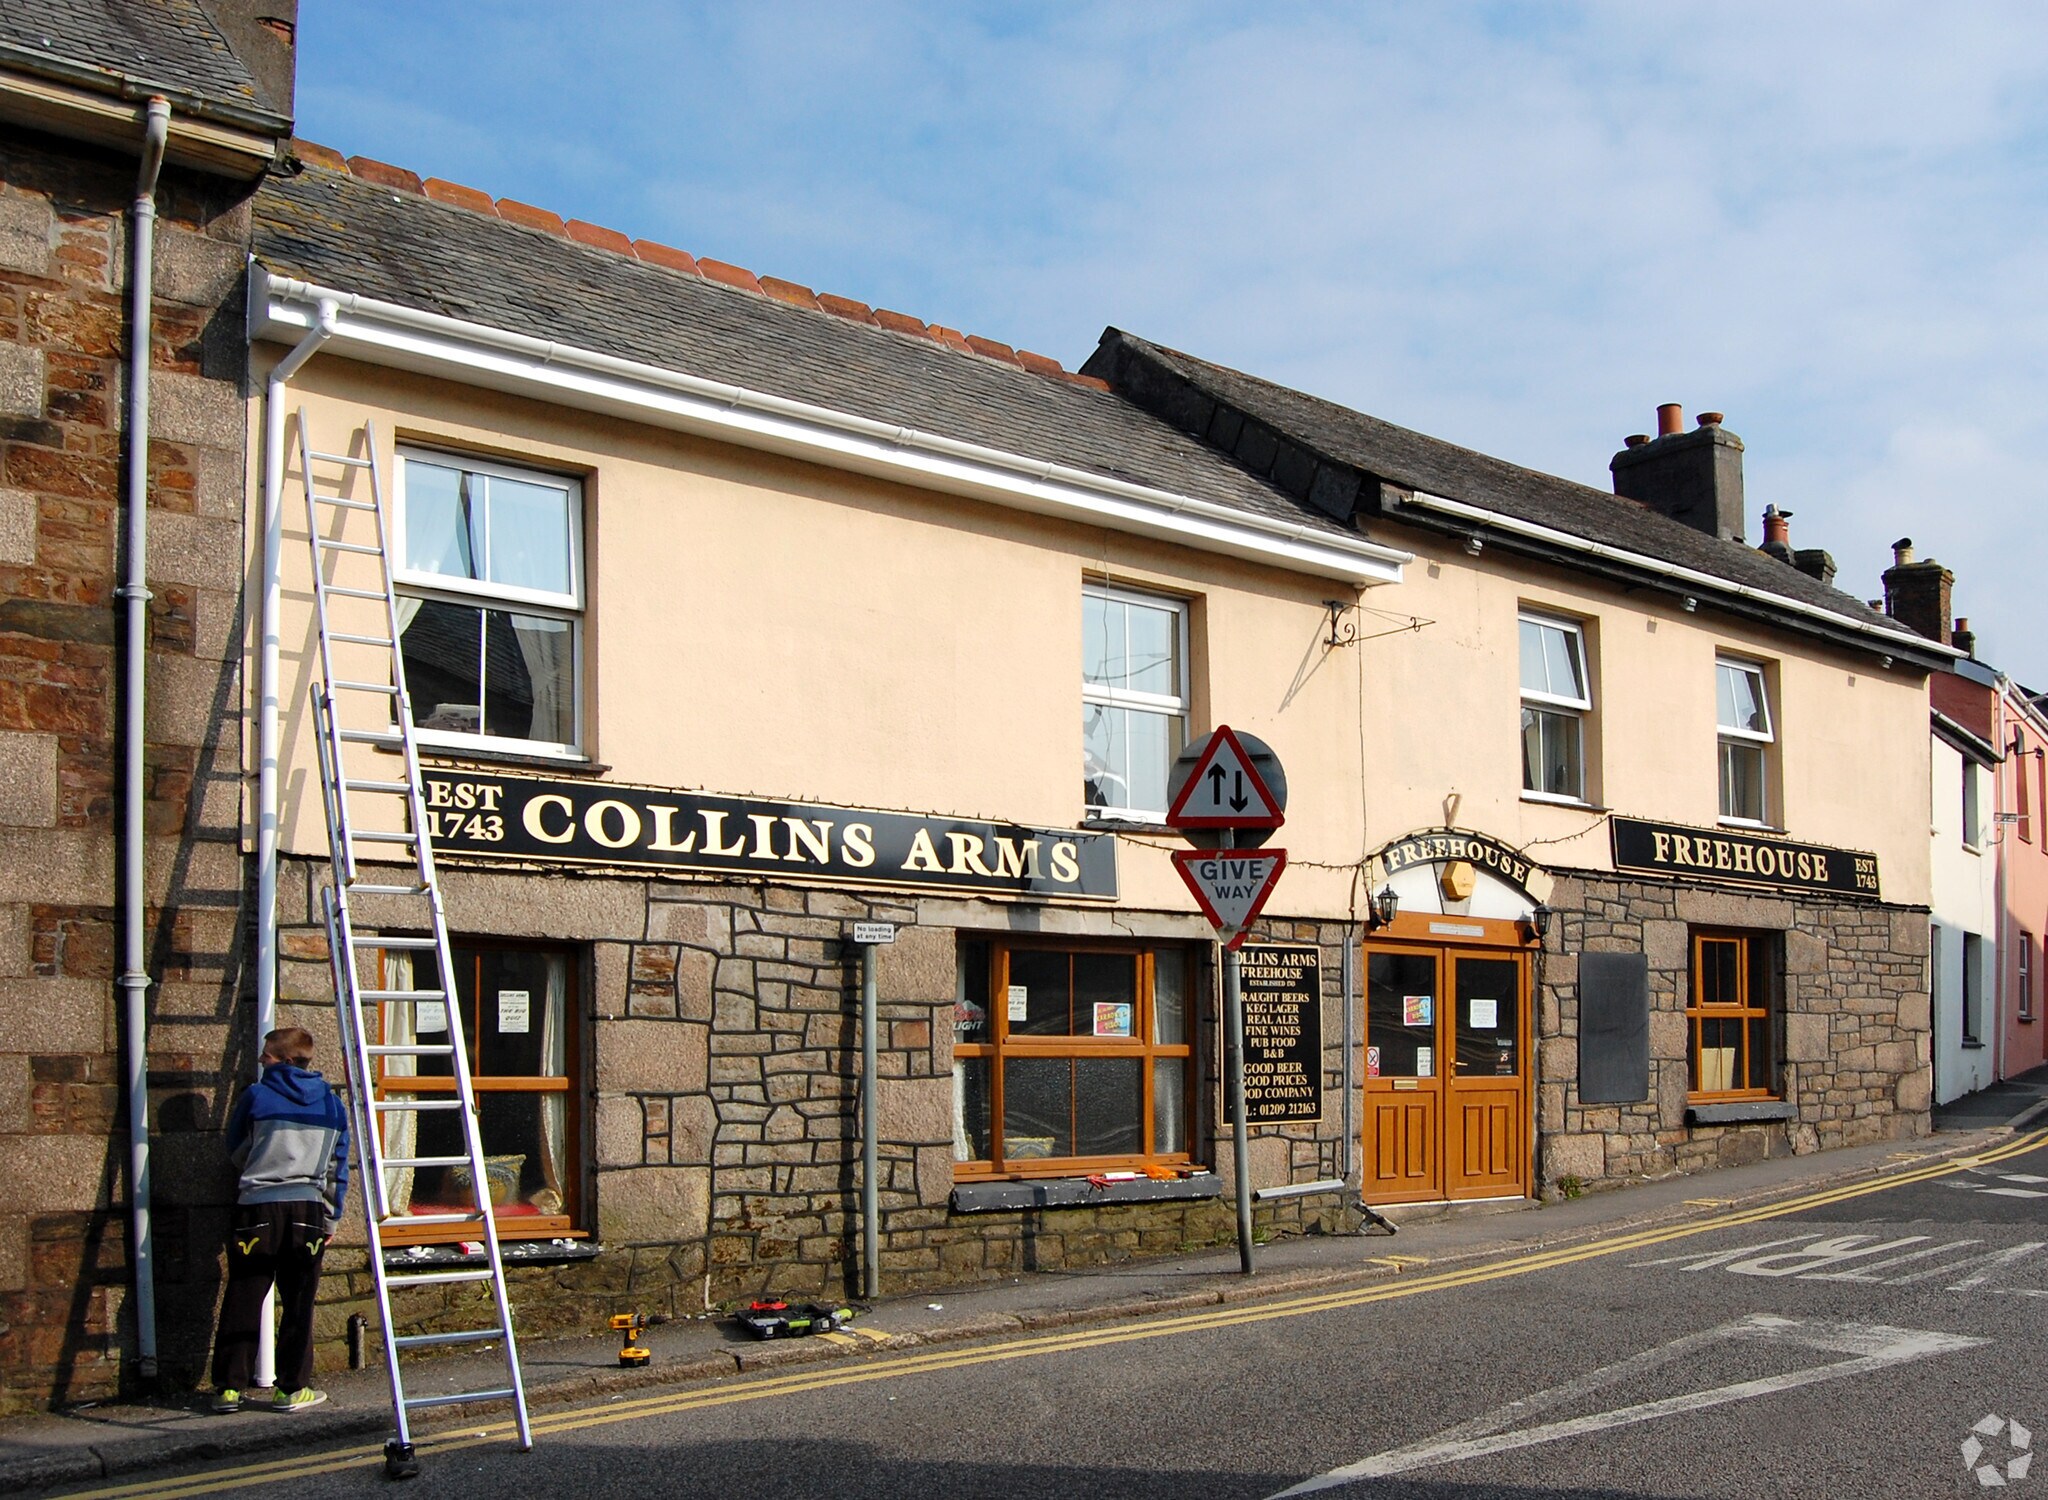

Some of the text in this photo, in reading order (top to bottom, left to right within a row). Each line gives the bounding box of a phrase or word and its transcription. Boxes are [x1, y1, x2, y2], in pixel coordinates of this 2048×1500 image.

[426, 780, 503, 811] EST
[429, 813, 505, 842] 1743
[522, 794, 1081, 883] COLLINS ARMS
[1385, 838, 1527, 883] FREEHOUSE
[1651, 831, 1829, 882] FREEHOUSE
[1200, 860, 1264, 881] GIVE
[1854, 858, 1875, 873] EST
[1855, 874, 1877, 889] 1743
[1215, 885, 1254, 899] WAY
[1238, 952, 1317, 967] OLLINS ARMS
[1241, 967, 1303, 979] FREEHOUSE
[1240, 992, 1310, 1003] RAUGHT BEERS
[1246, 1003, 1300, 1014] KEG LAGER
[953, 1021, 984, 1031] LIGHT
[1247, 1014, 1299, 1025] REAL ALES
[1245, 1026, 1301, 1036] FINE WINES
[1250, 1038, 1296, 1048] PUB FOOD
[1263, 1049, 1285, 1059] B&B
[1244, 1063, 1303, 1074] GOOD BEER
[1272, 1074, 1308, 1086] PRICES
[1264, 1086, 1314, 1099] COMPANY
[1259, 1103, 1286, 1116] 01209
[1288, 1102, 1316, 1115] 212163
